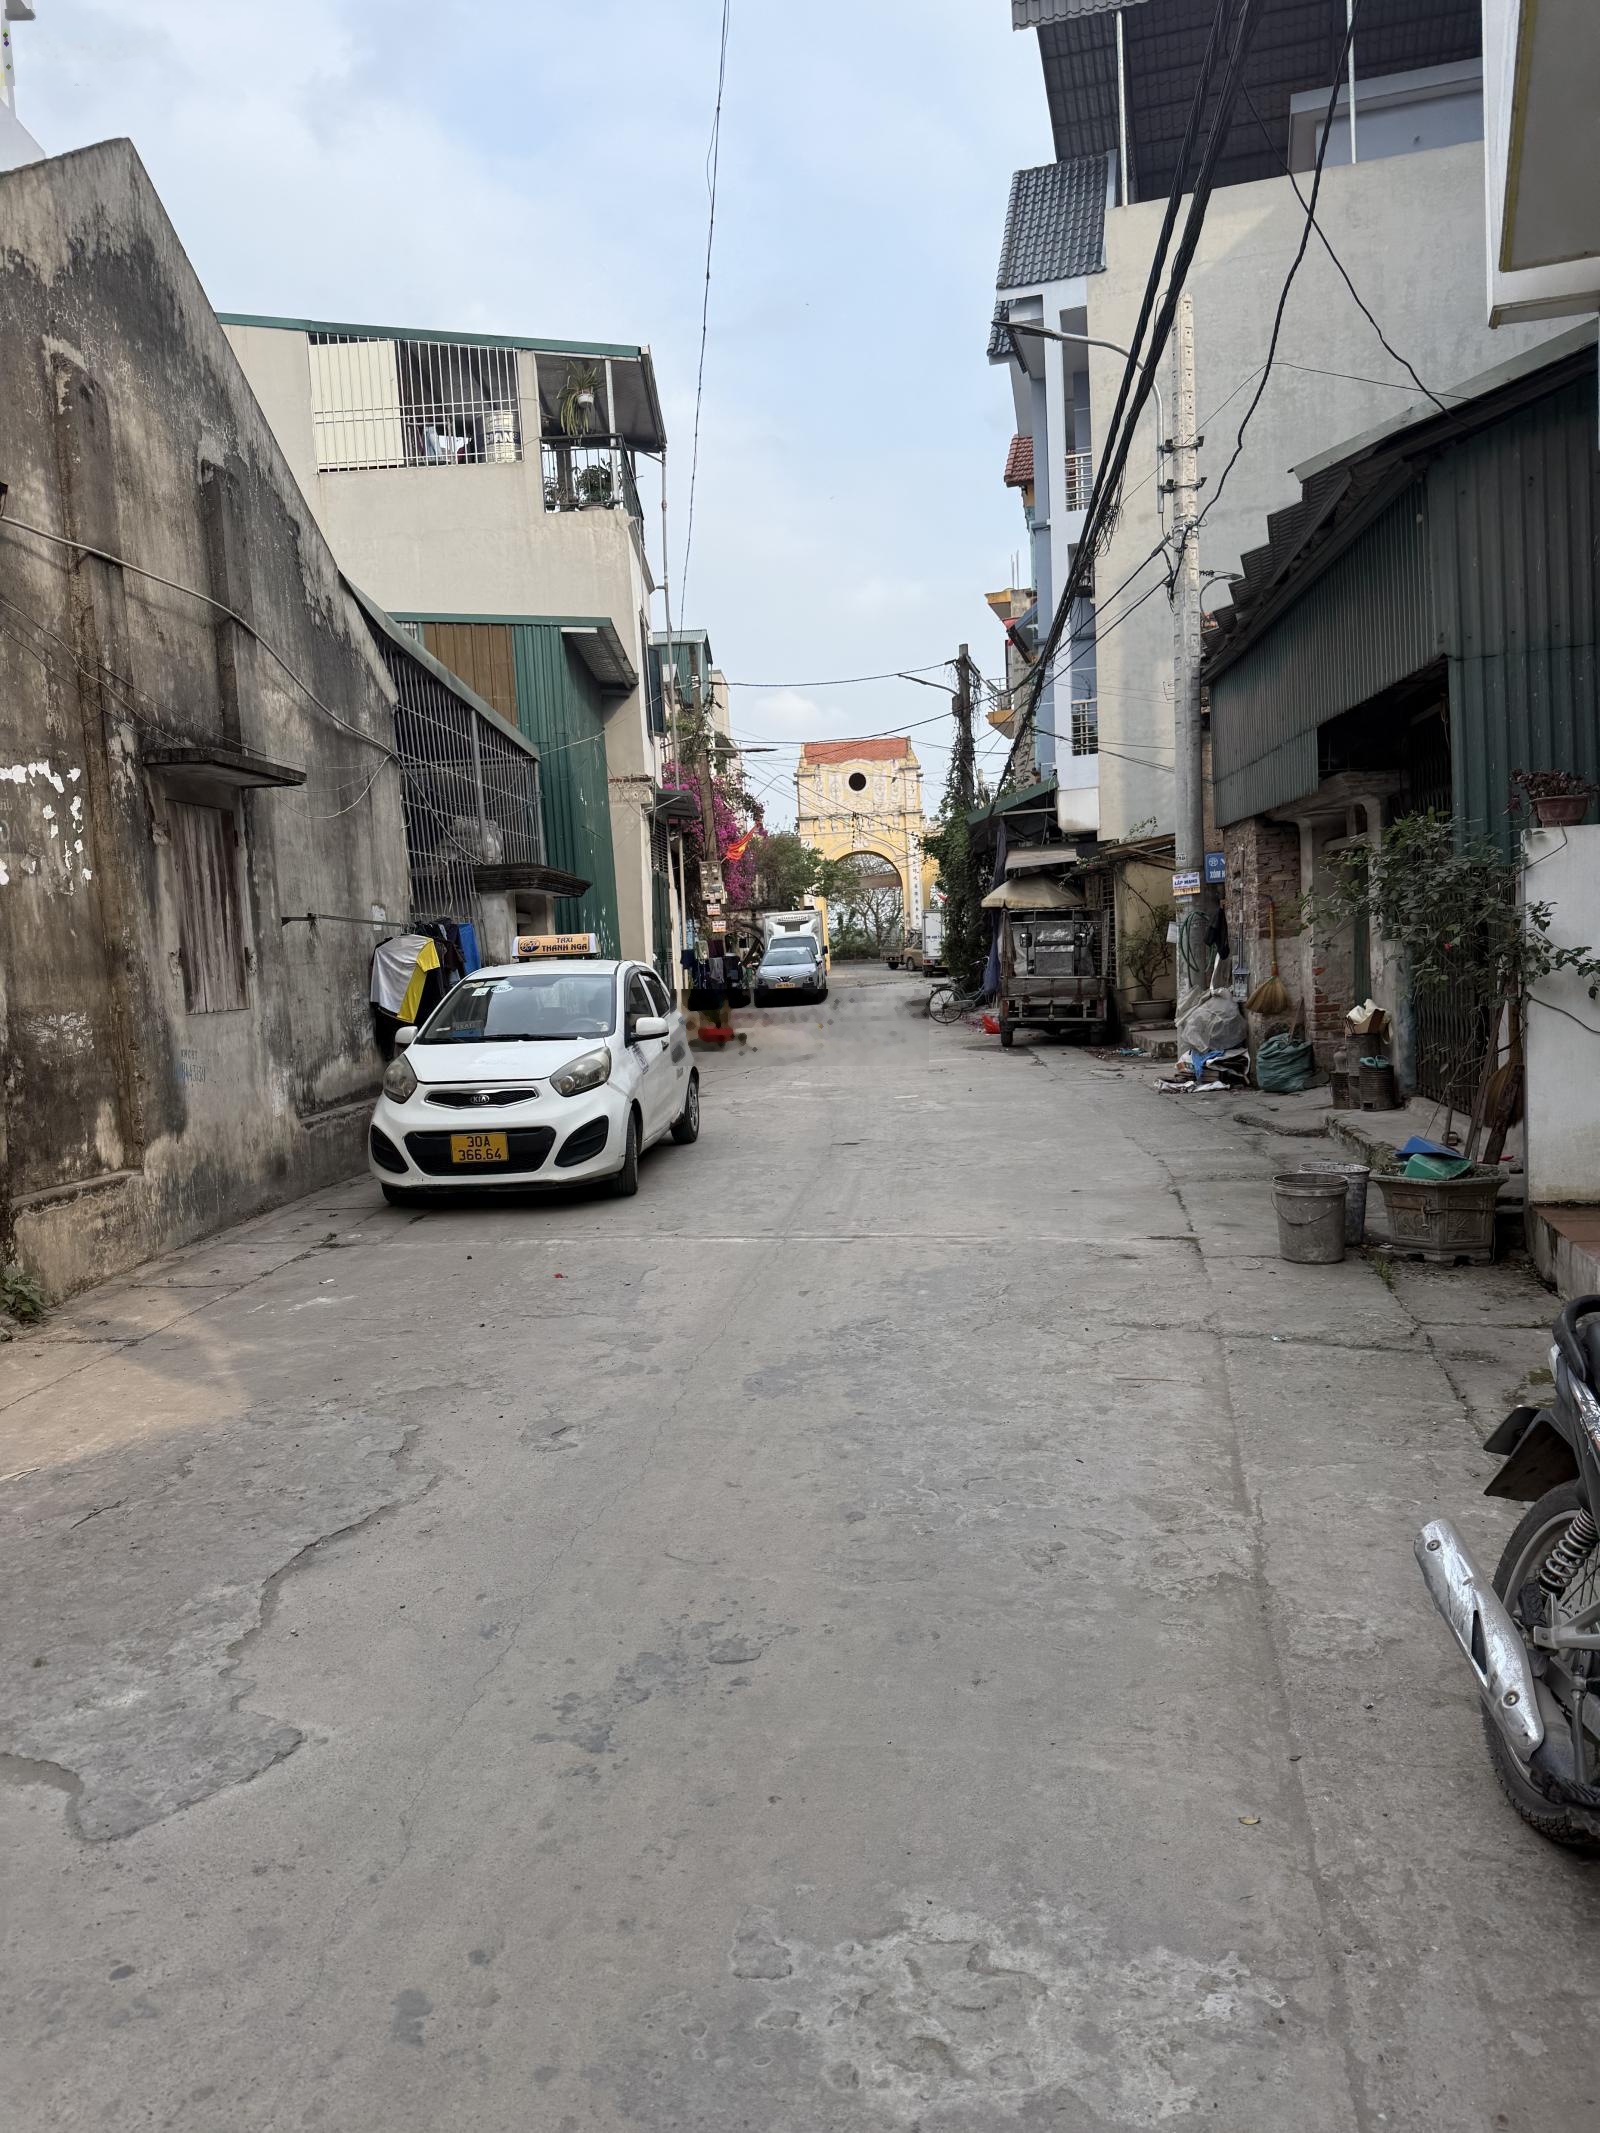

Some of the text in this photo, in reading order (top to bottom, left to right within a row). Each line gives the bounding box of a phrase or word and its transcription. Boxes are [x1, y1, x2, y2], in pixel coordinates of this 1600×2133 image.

[542, 944, 569, 952] THANH
[571, 943, 588, 951] NGA
[466, 1135, 491, 1148] 30A
[458, 1148, 502, 1161] 366.64
